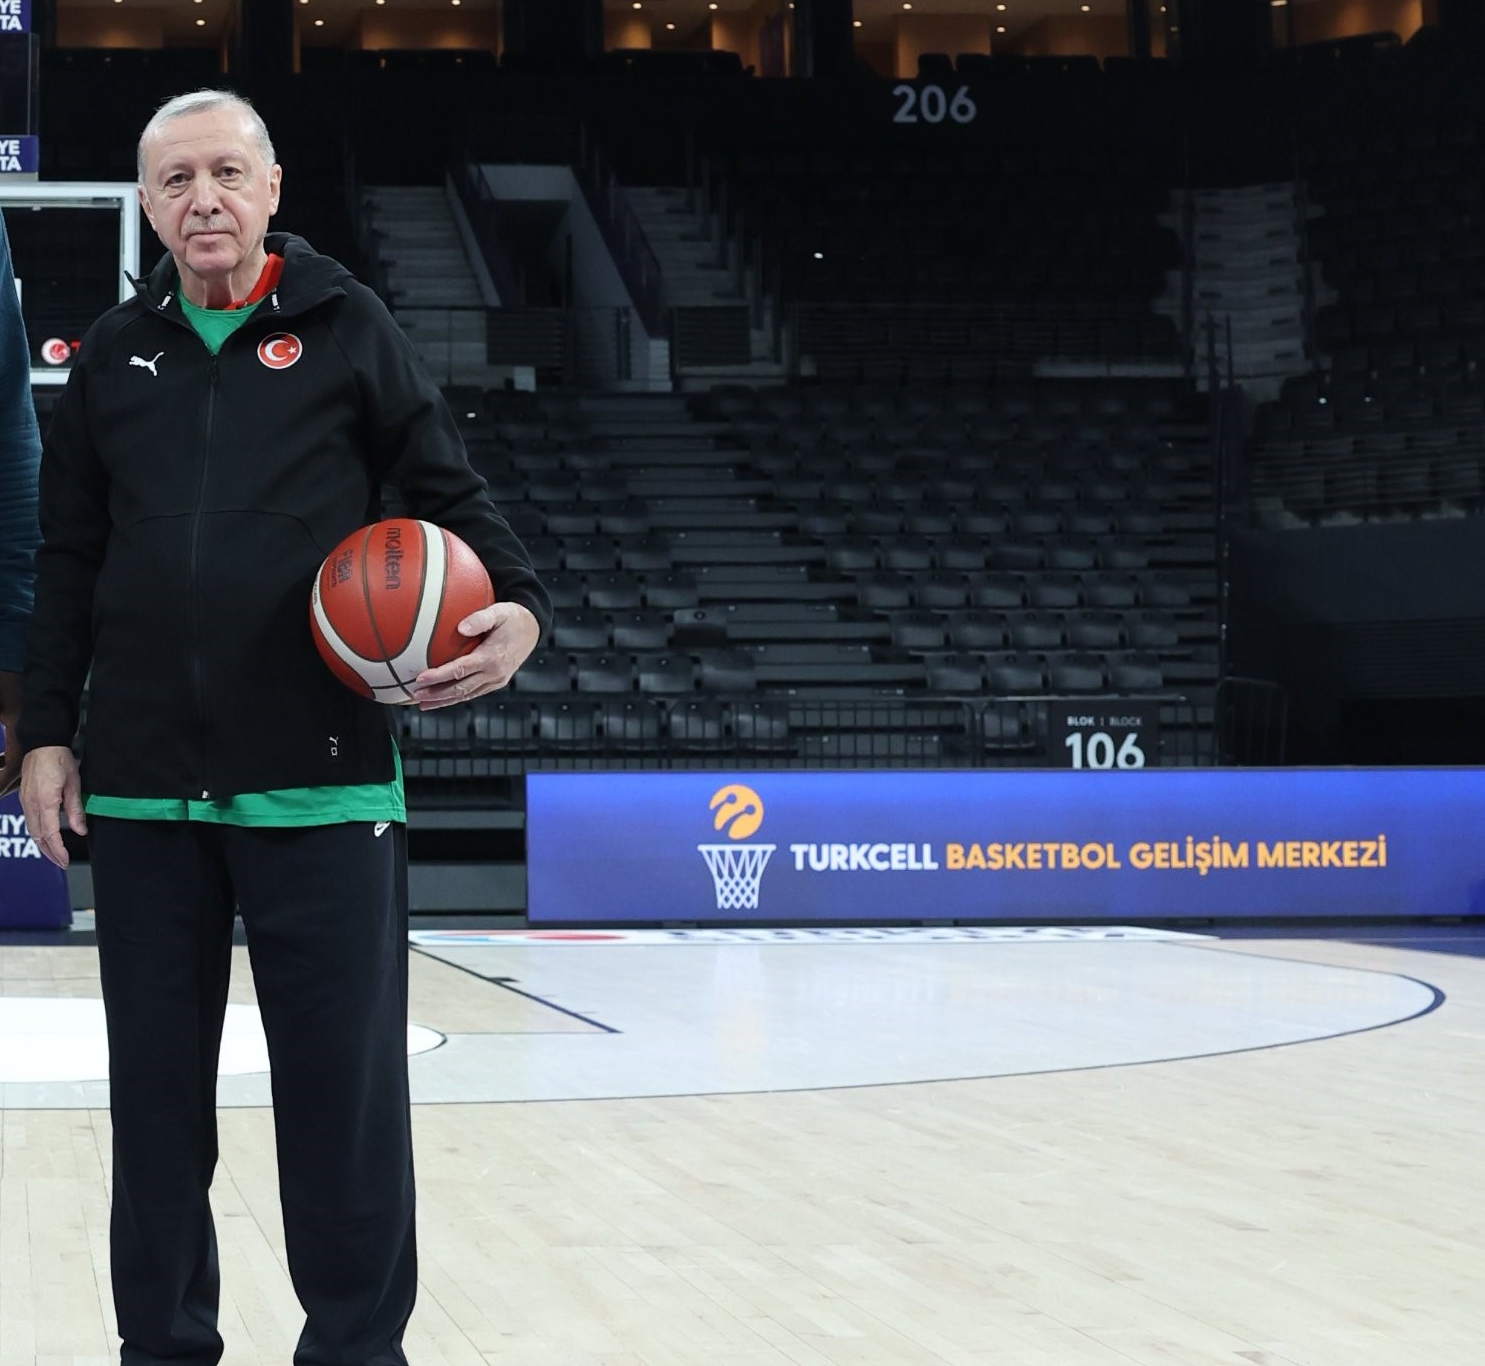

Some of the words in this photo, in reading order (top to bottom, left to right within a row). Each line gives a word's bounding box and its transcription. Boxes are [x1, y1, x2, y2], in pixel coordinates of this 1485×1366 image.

[893, 84, 976, 123] 206
[384, 527, 404, 590] molten
[1067, 716, 1095, 726] BLOK
[1065, 732, 1145, 769] 106
[789, 843, 939, 871] TURKCELL
[945, 840, 1122, 872] BASKETBOL
[1128, 835, 1249, 876] GELİŞİM
[1256, 833, 1387, 869] MERKEZİ
